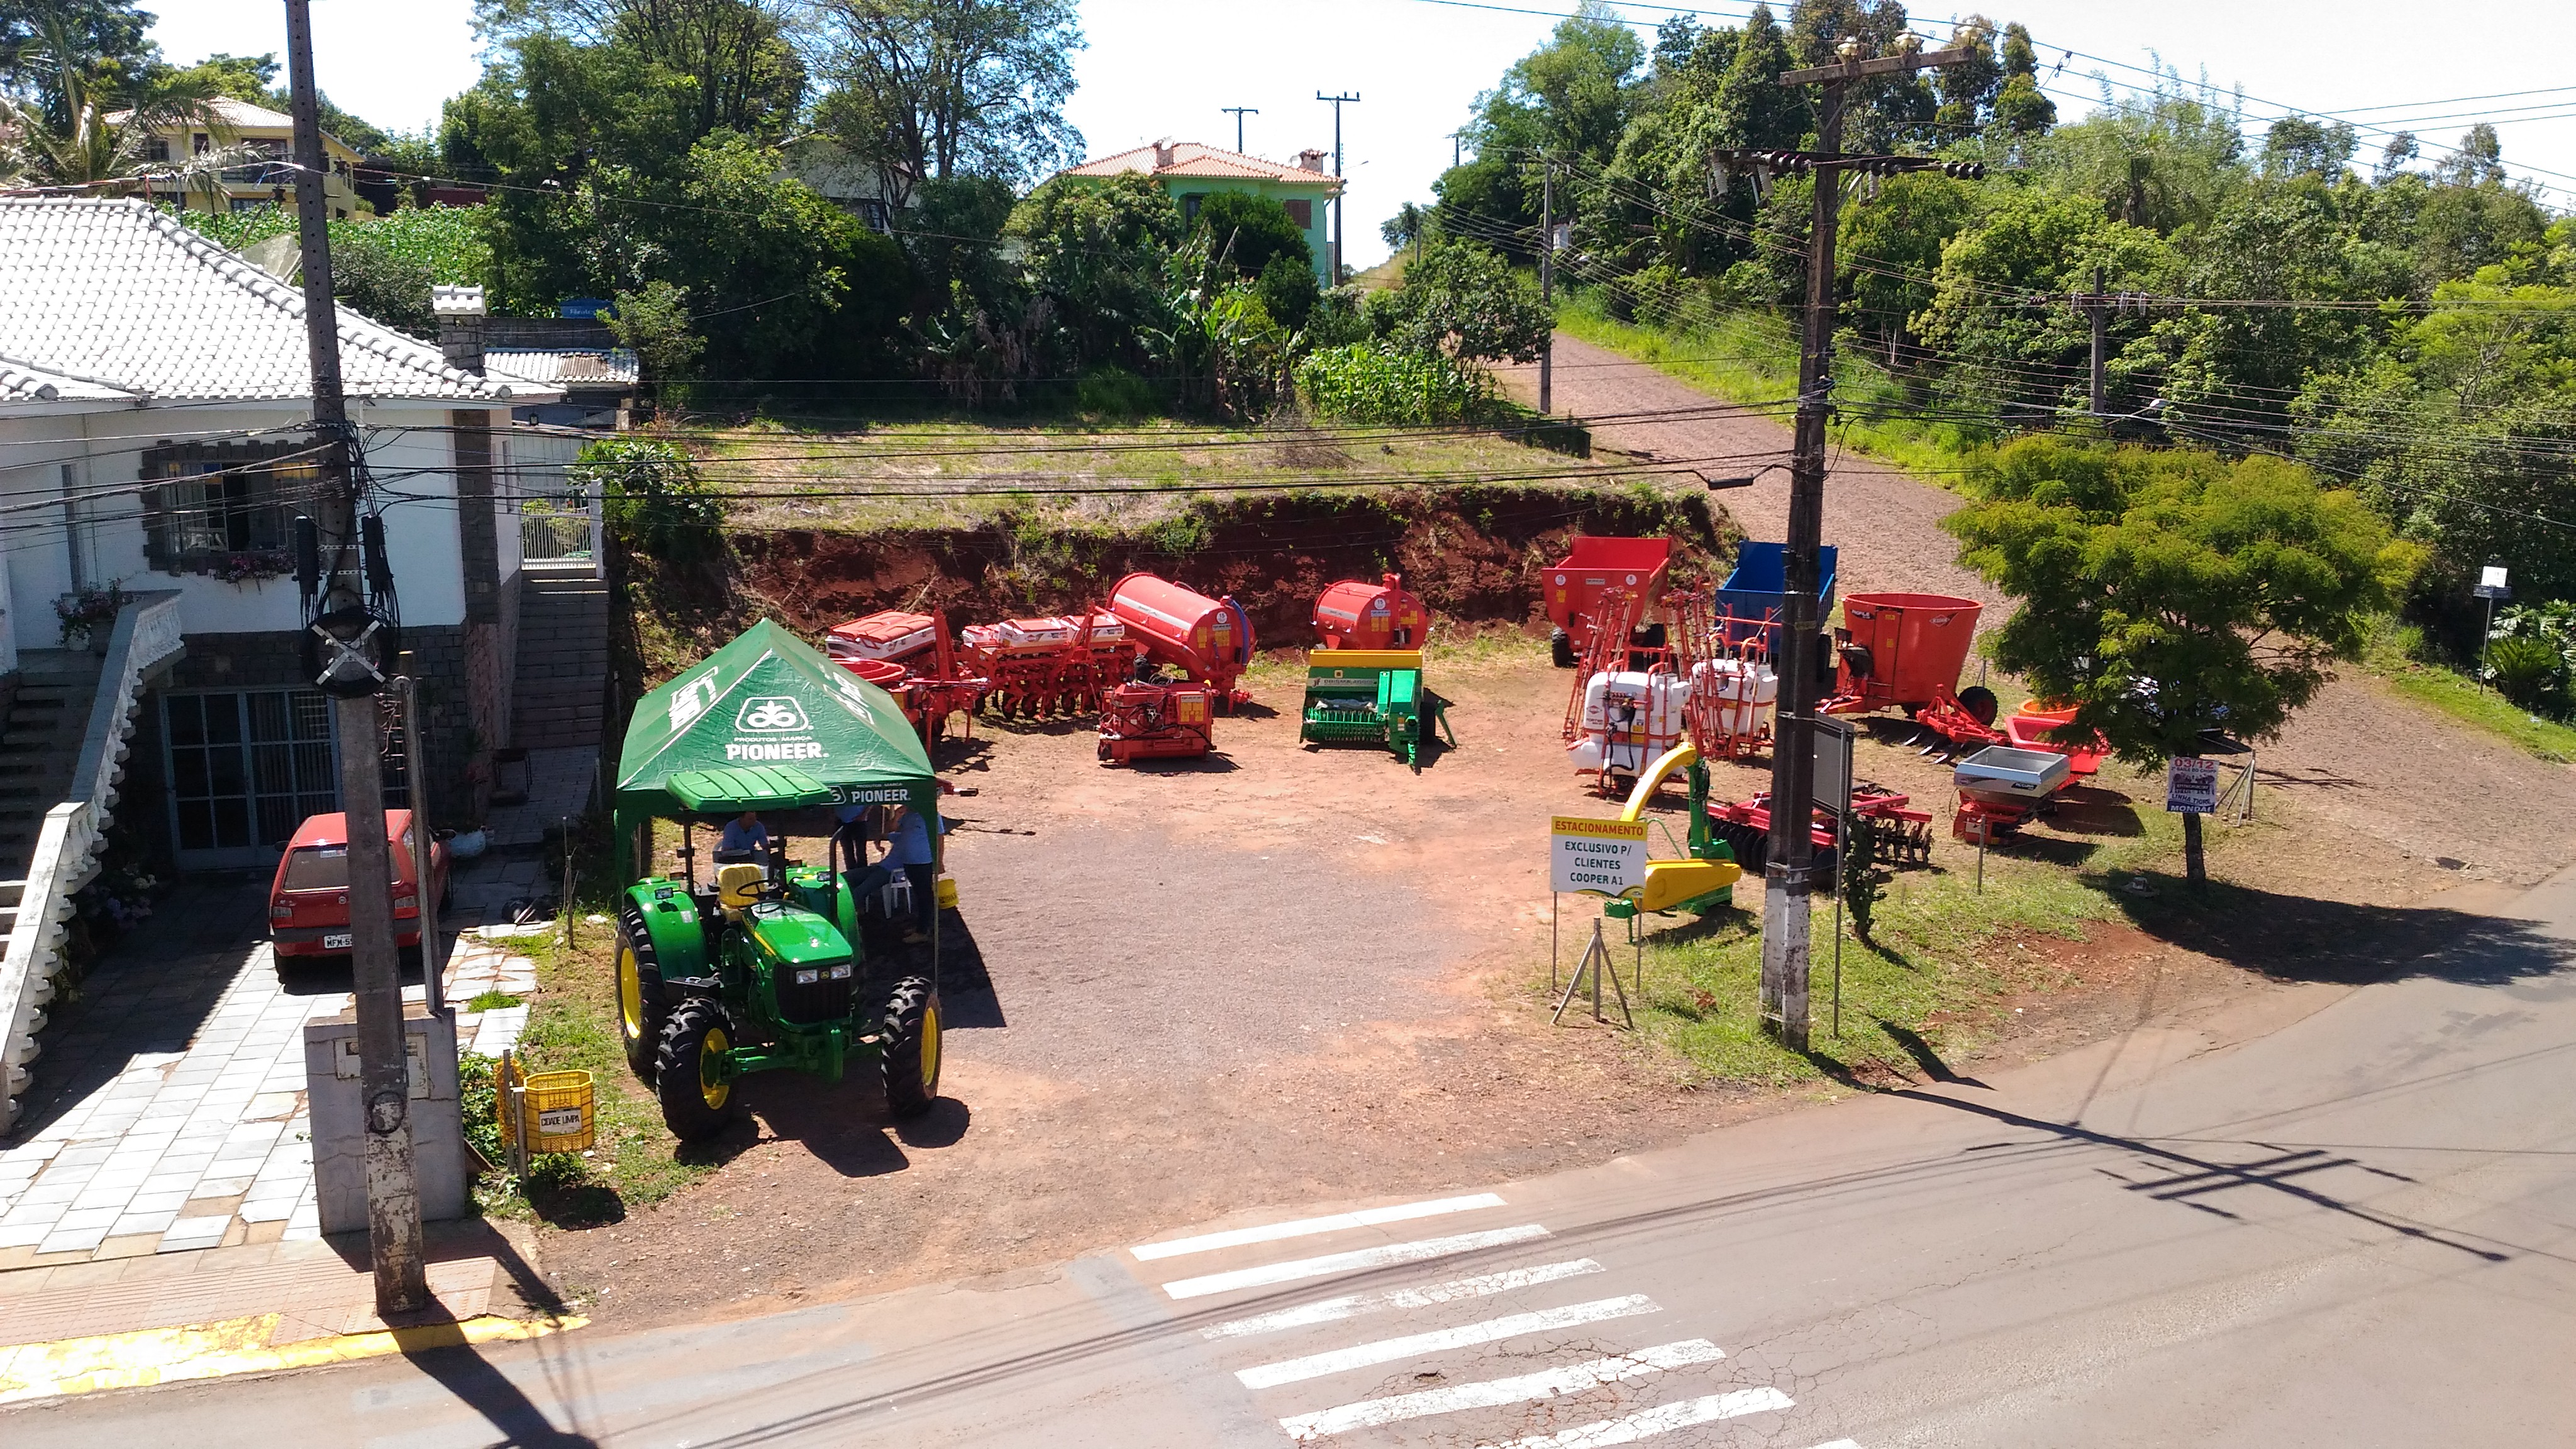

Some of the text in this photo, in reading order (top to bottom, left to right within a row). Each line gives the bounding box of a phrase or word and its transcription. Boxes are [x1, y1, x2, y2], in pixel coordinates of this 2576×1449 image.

[725, 742, 823, 760] PIONEER
[2174, 758, 2214, 769] 03/12
[851, 789, 908, 803] PIONEER
[2172, 794, 2191, 802] LINHA
[1555, 821, 1643, 836] ESTACIONAMENTO
[1565, 841, 1632, 856] EXCLUSIVO P/
[1574, 857, 1621, 869] CLIENTES
[1570, 872, 1623, 886] COOPER A1
[541, 1114, 580, 1126] CIDADE LIMPA
